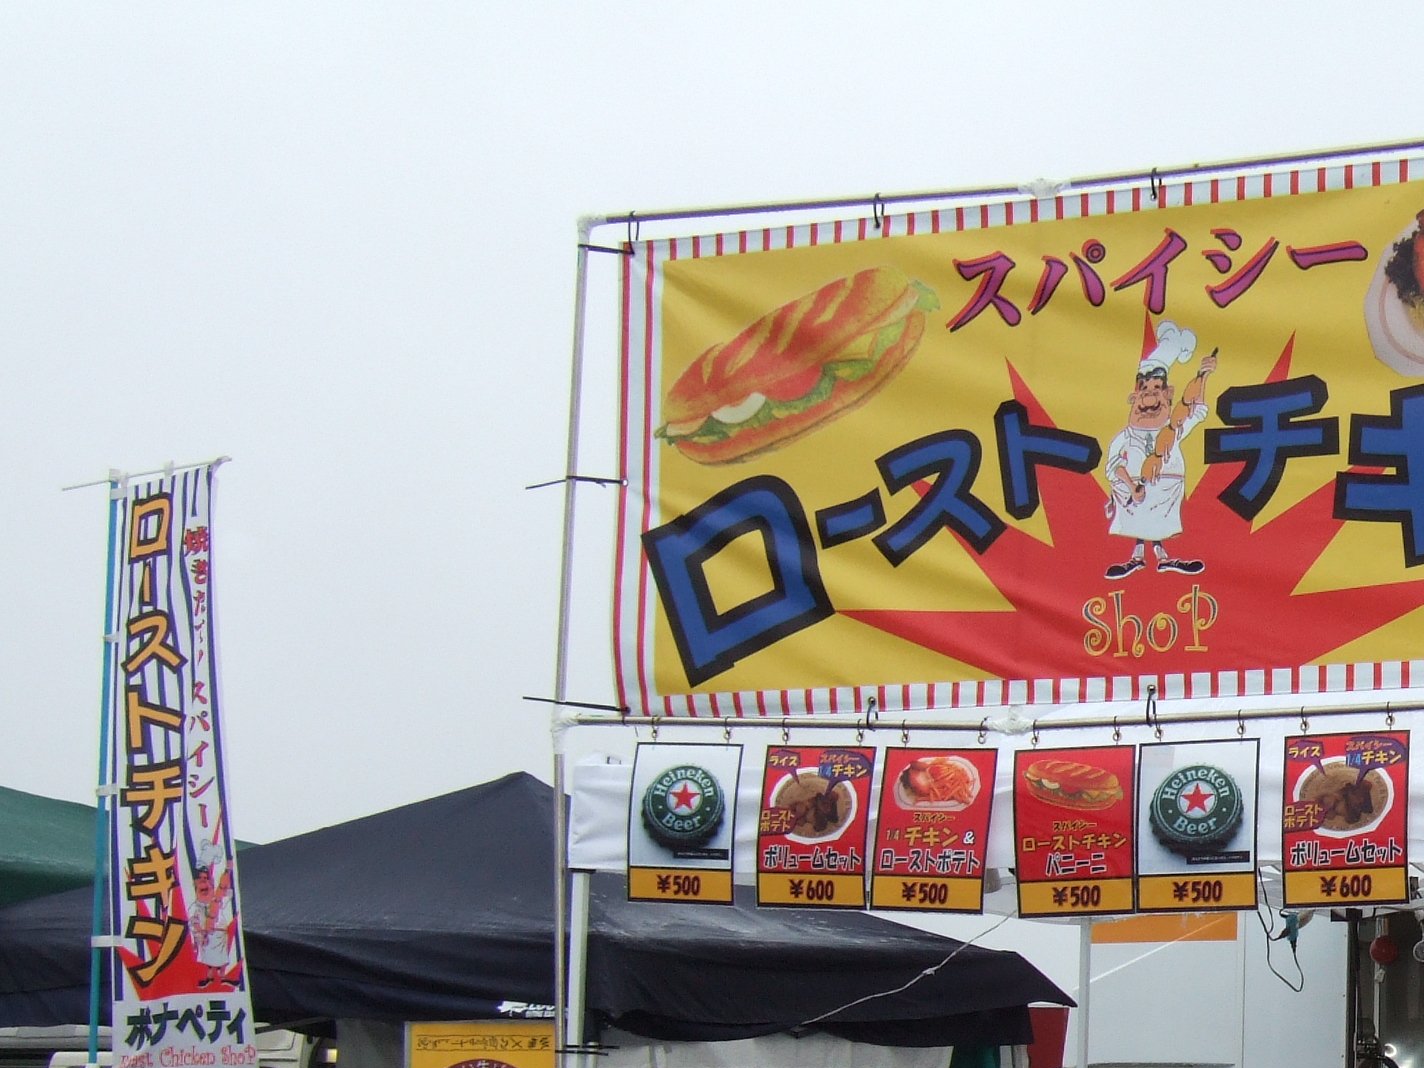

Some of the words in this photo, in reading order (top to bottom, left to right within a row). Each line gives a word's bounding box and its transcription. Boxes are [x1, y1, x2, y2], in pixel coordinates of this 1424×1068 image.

[946, 226, 1368, 332] スパイシー
[121, 496, 189, 989] ローストチキン
[1289, 746, 1321, 758] ライス
[769, 756, 797, 766] ライス
[654, 768, 715, 797] Heineken
[1162, 769, 1230, 800] Heineken
[662, 812, 702, 830] Beer
[1173, 816, 1217, 834] Beer
[904, 826, 959, 847] チキン
[963, 831, 975, 844] &
[1022, 833, 1127, 851] ローストチキン
[764, 845, 862, 871] ボリュームセット
[880, 848, 981, 874] ローストポテト
[1290, 837, 1403, 866] ボリュームセット
[1046, 852, 1107, 876] パニーニ
[656, 874, 701, 895] ¥500
[790, 879, 834, 900] ¥600
[902, 882, 948, 904] ¥500
[1173, 881, 1223, 902] ¥500
[1320, 875, 1371, 897] ¥600
[1052, 885, 1100, 907] ¥500
[125, 1000, 246, 1050] ボナペティ
[159, 1046, 215, 1067] Chicken
